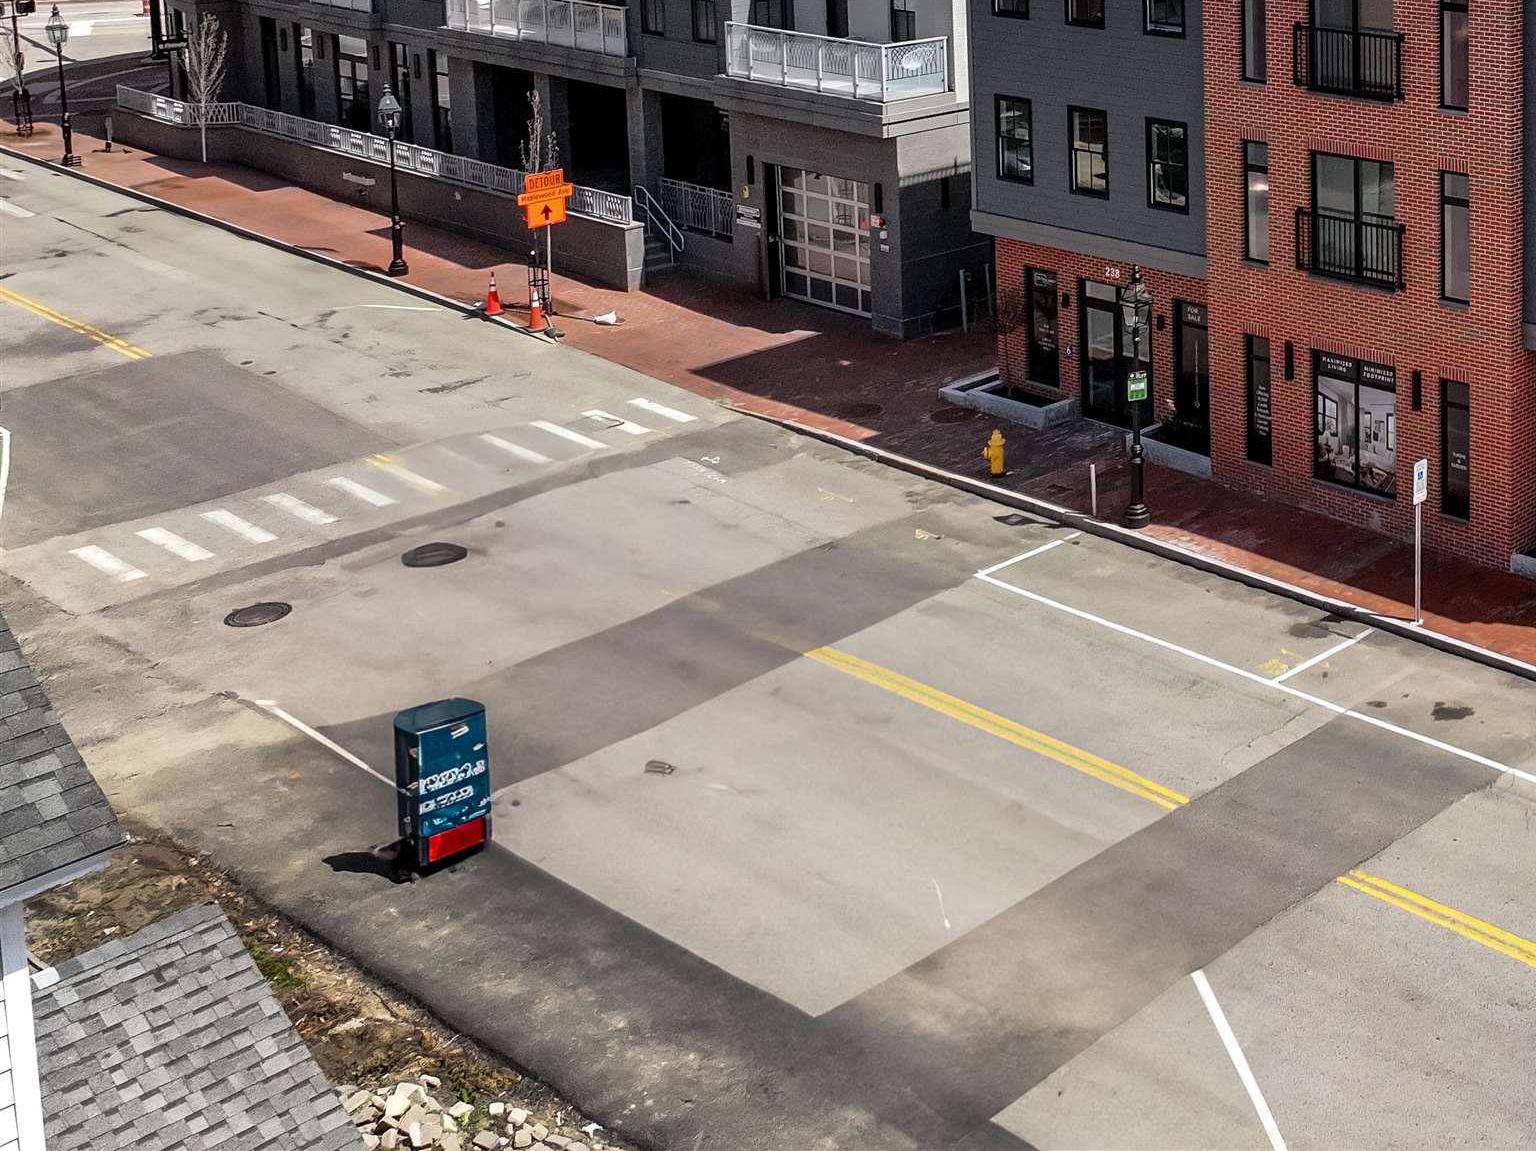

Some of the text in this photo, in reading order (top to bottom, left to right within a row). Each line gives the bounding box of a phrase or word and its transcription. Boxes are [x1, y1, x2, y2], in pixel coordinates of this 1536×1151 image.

[529, 173, 561, 190] DETOUR
[1105, 266, 1121, 279] 238
[1187, 306, 1199, 315] FOR
[1187, 313, 1201, 323] SALE
[1322, 356, 1353, 368] MAXIMIZED
[1327, 363, 1347, 373] LIVING
[1362, 371, 1394, 383] FOOTPRINT
[1363, 365, 1394, 377] MINIMIZED
